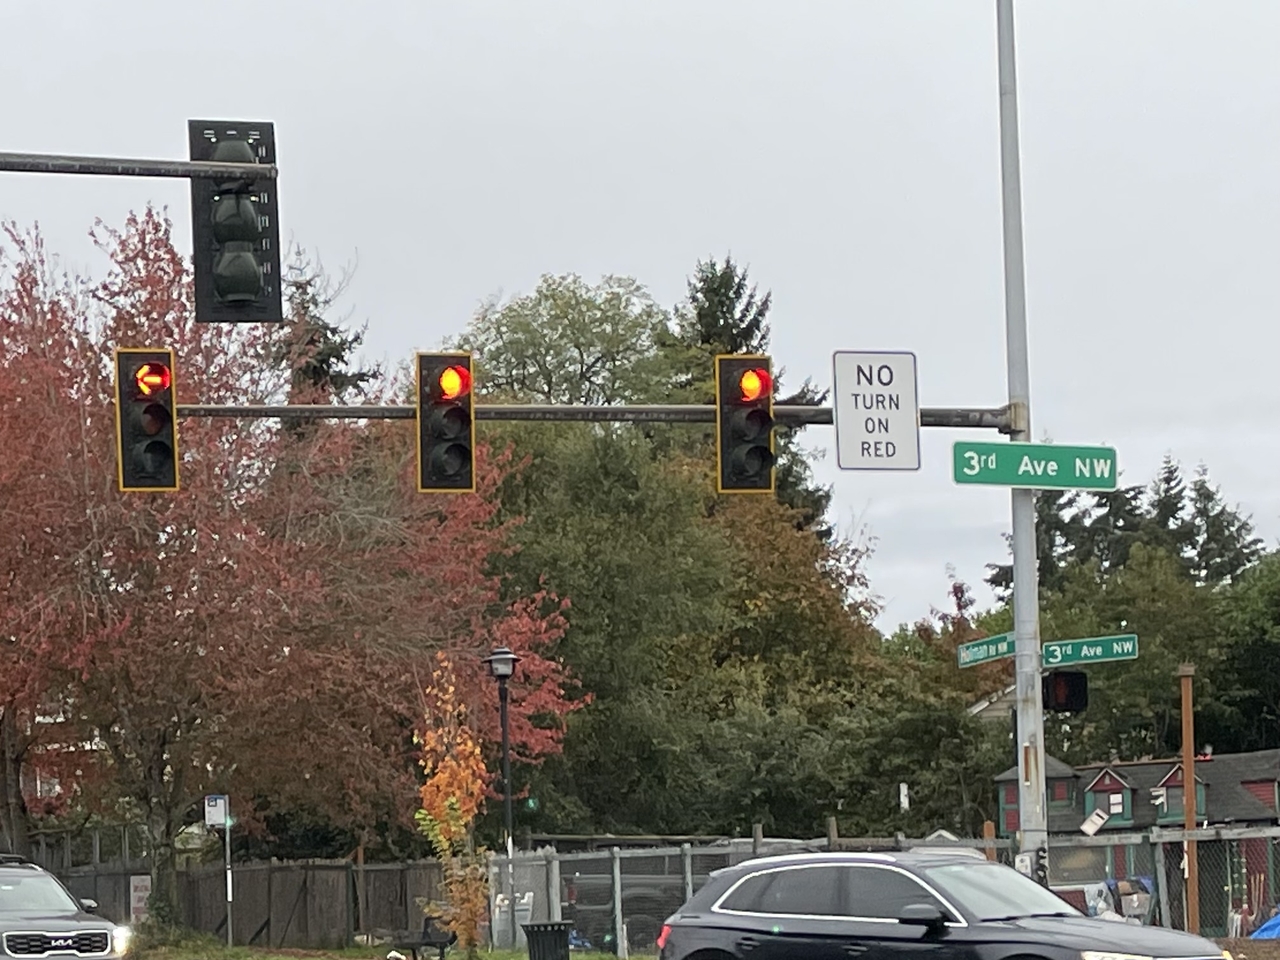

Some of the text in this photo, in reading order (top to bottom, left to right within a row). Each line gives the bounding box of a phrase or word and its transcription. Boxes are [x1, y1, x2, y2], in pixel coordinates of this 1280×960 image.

[857, 364, 894, 387] NO
[851, 393, 900, 410] TURN
[864, 417, 889, 434] ON
[860, 441, 896, 458] RED
[963, 450, 1112, 479] 3rd Ave NW
[1048, 640, 1134, 663] 3rd Ave NW
